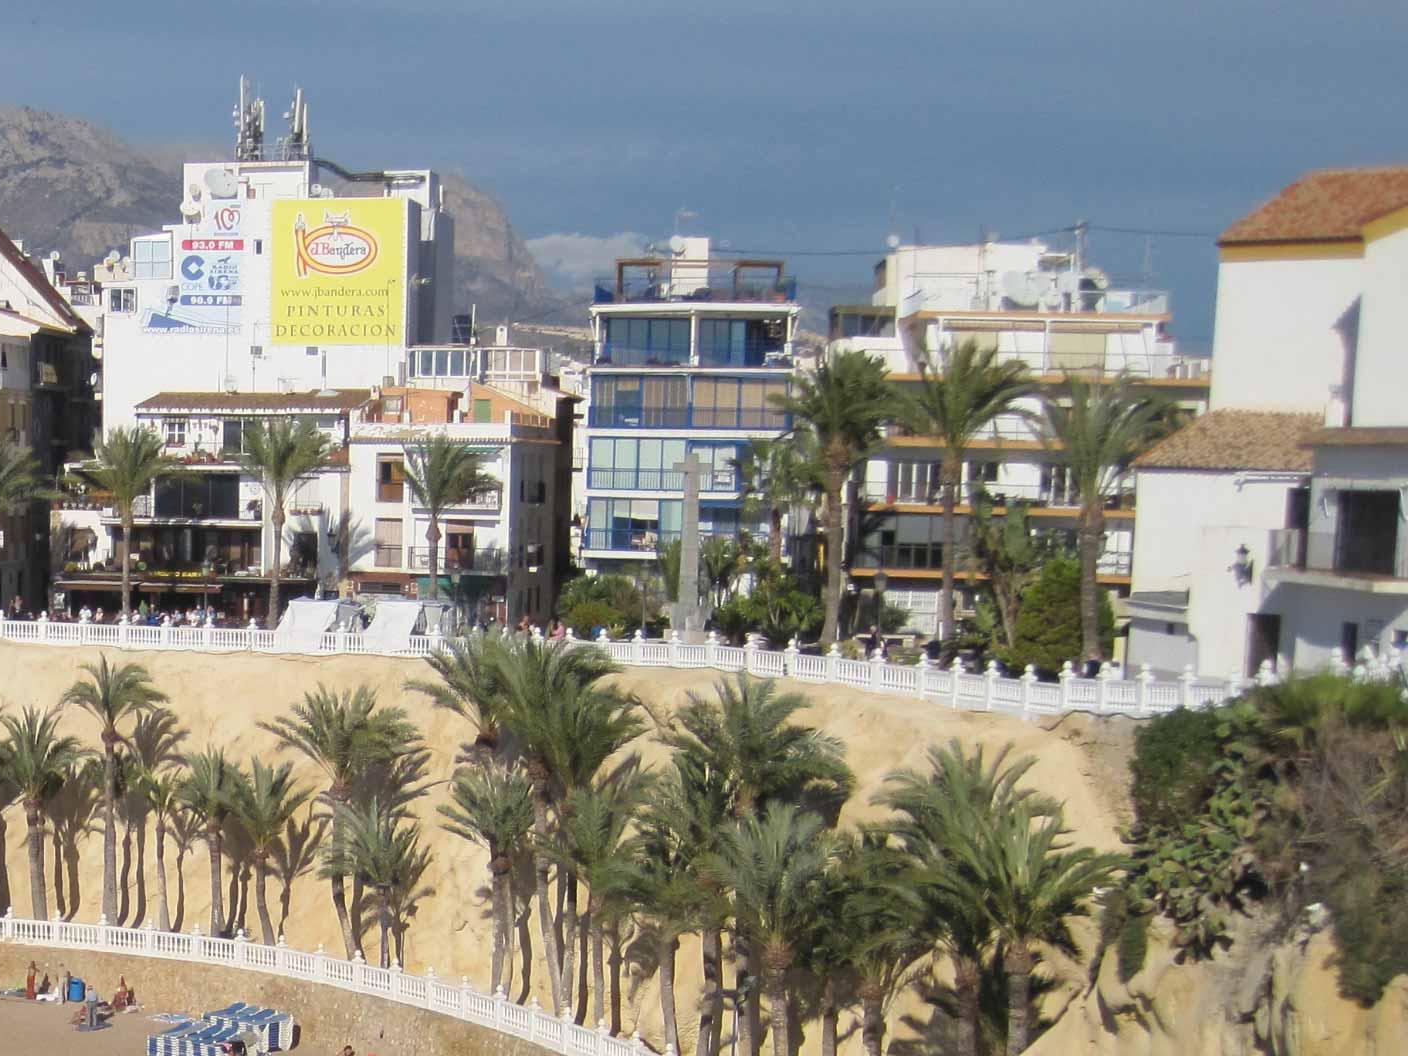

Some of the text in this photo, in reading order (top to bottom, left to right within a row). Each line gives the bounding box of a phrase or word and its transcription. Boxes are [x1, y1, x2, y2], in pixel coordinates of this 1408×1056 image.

[218, 241, 234, 250] FM
[281, 286, 389, 298] www.jbandera.com
[216, 295, 232, 305] FM
[287, 305, 385, 317] PINTURAS
[276, 324, 396, 337] DECORACION
